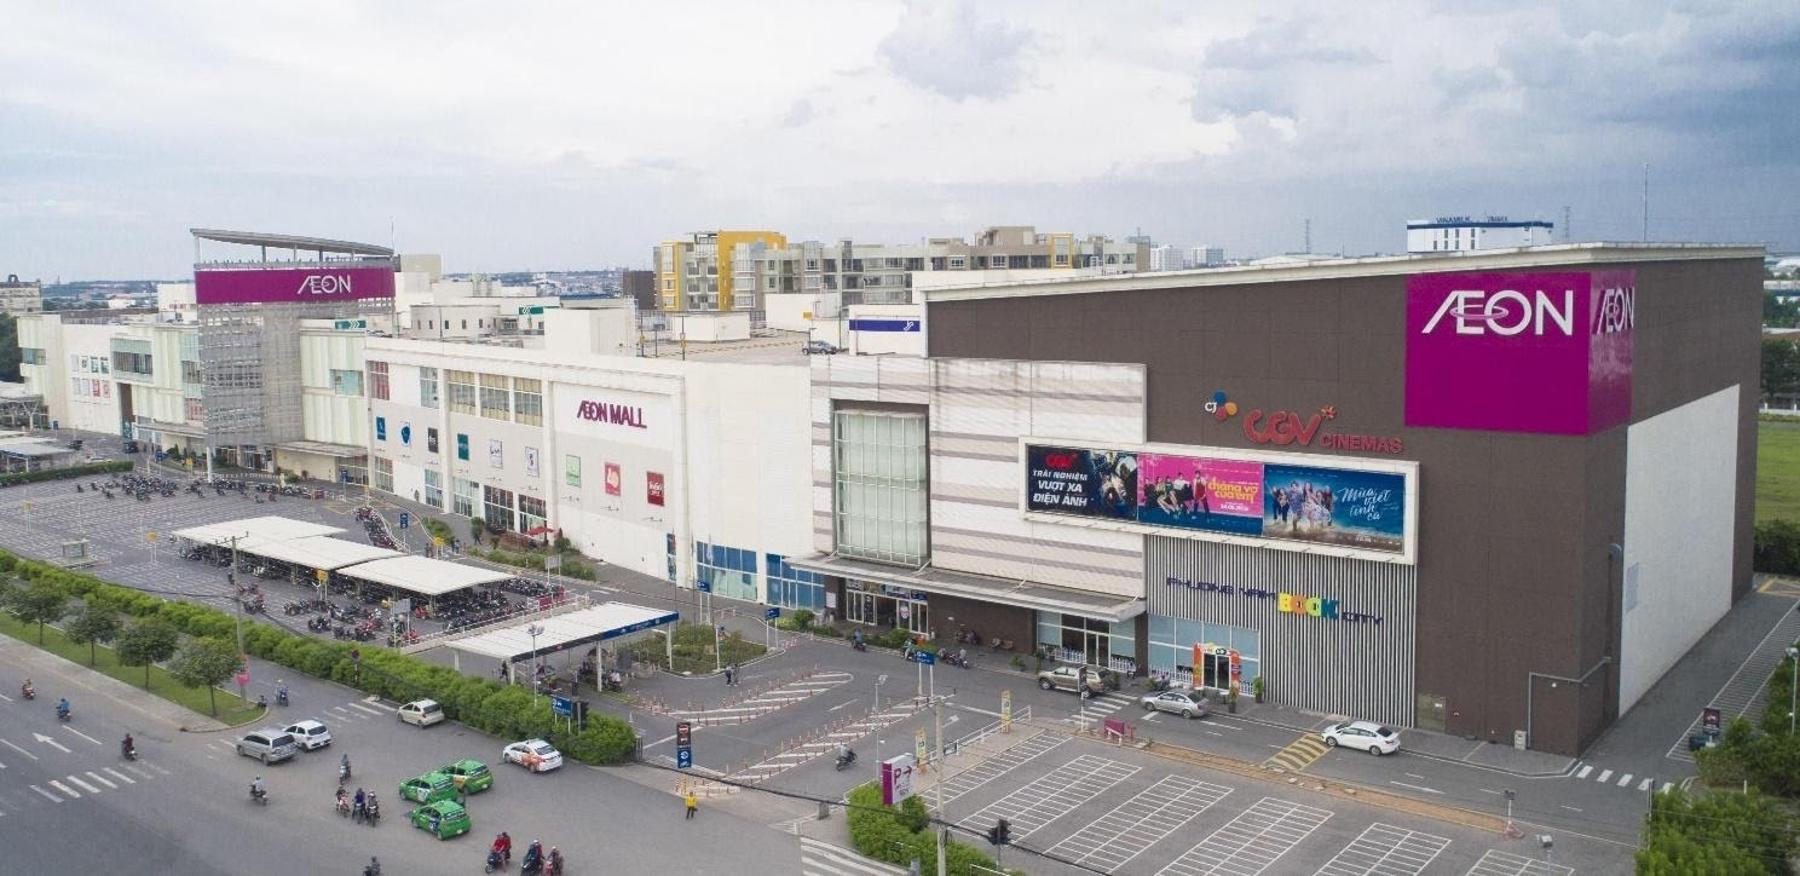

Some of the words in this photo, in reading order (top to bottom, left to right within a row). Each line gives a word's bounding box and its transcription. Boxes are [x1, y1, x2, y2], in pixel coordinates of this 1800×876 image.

[610, 404, 647, 429] MALL
[1204, 401, 1218, 413] CJ
[1243, 409, 1322, 445] CGV
[1319, 432, 1404, 453] CINEMAS
[1067, 482, 1082, 493] XA
[1278, 592, 1340, 621] BOOK
